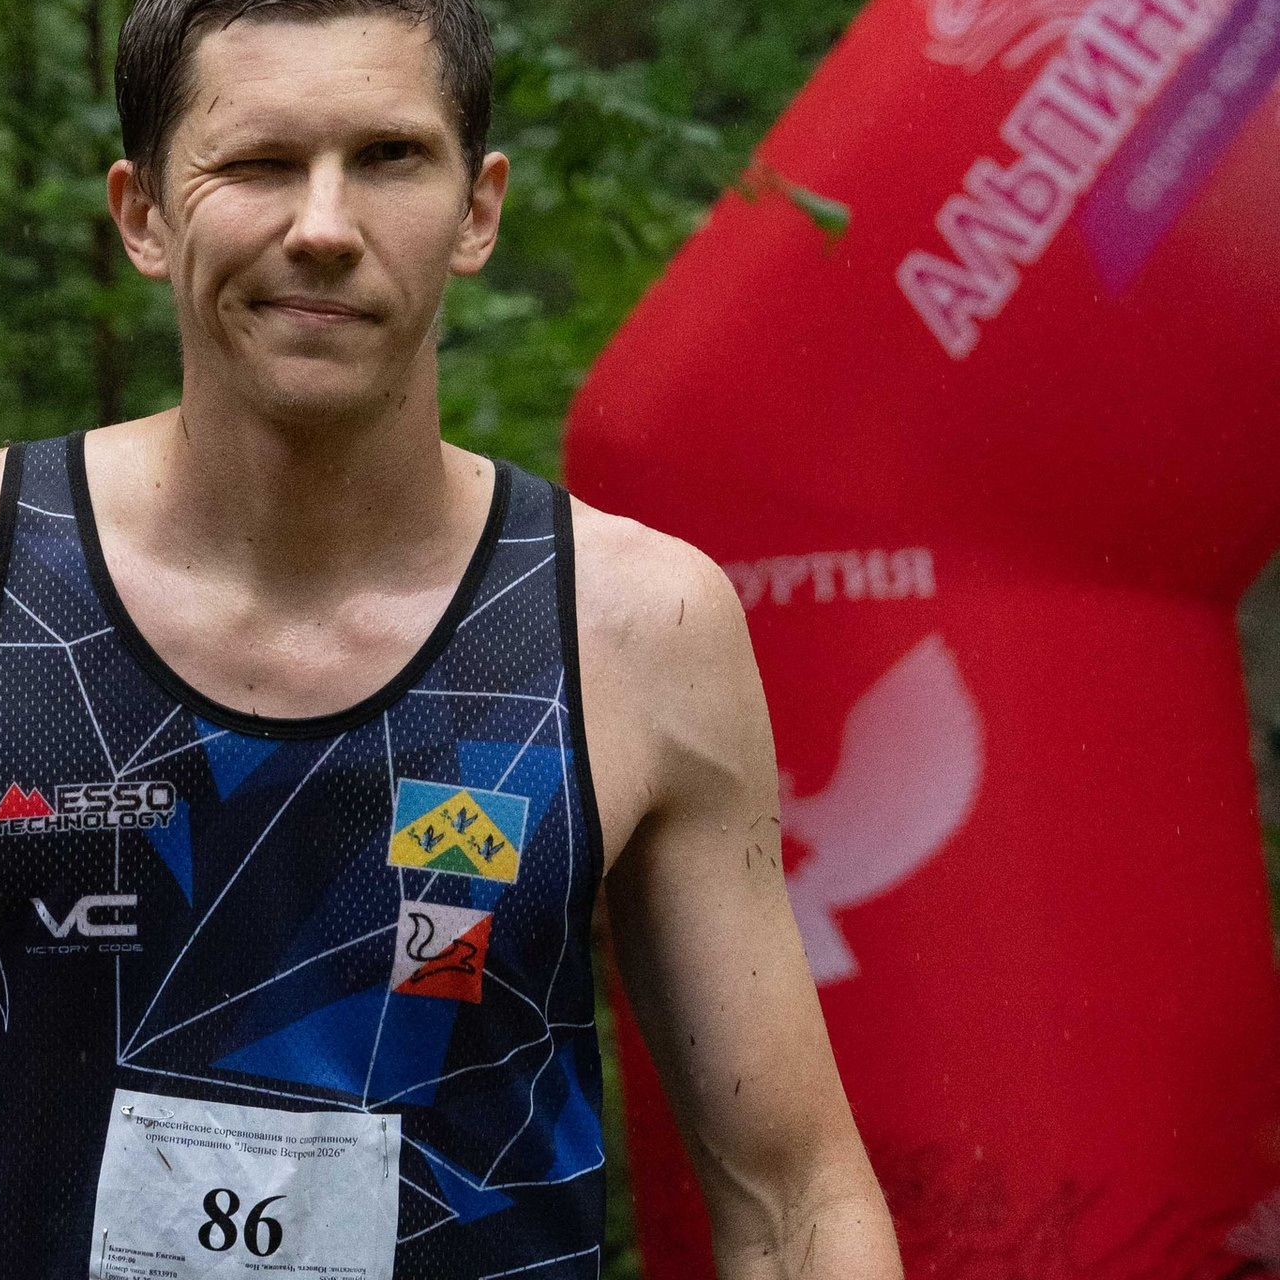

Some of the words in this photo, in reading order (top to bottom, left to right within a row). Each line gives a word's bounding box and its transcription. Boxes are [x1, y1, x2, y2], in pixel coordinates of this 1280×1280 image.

[30, 895, 138, 938] VC
[25, 945, 90, 954] VICTORY
[99, 943, 144, 952] CODE
[136, 1116, 212, 1135] Всероссийские
[214, 1127, 283, 1143] соревнования
[285, 1136, 297, 1144] по
[300, 1136, 358, 1146] спортивному
[145, 1133, 231, 1150] ориентированию
[235, 1142, 277, 1156] "Лесные
[280, 1148, 315, 1160] Встречи
[316, 1148, 345, 1158] 2026"
[198, 1188, 287, 1257] 86
[156, 1251, 186, 1261] Евгений
[106, 1263, 128, 1273] Номер
[149, 1270, 177, 1278] 8533910
